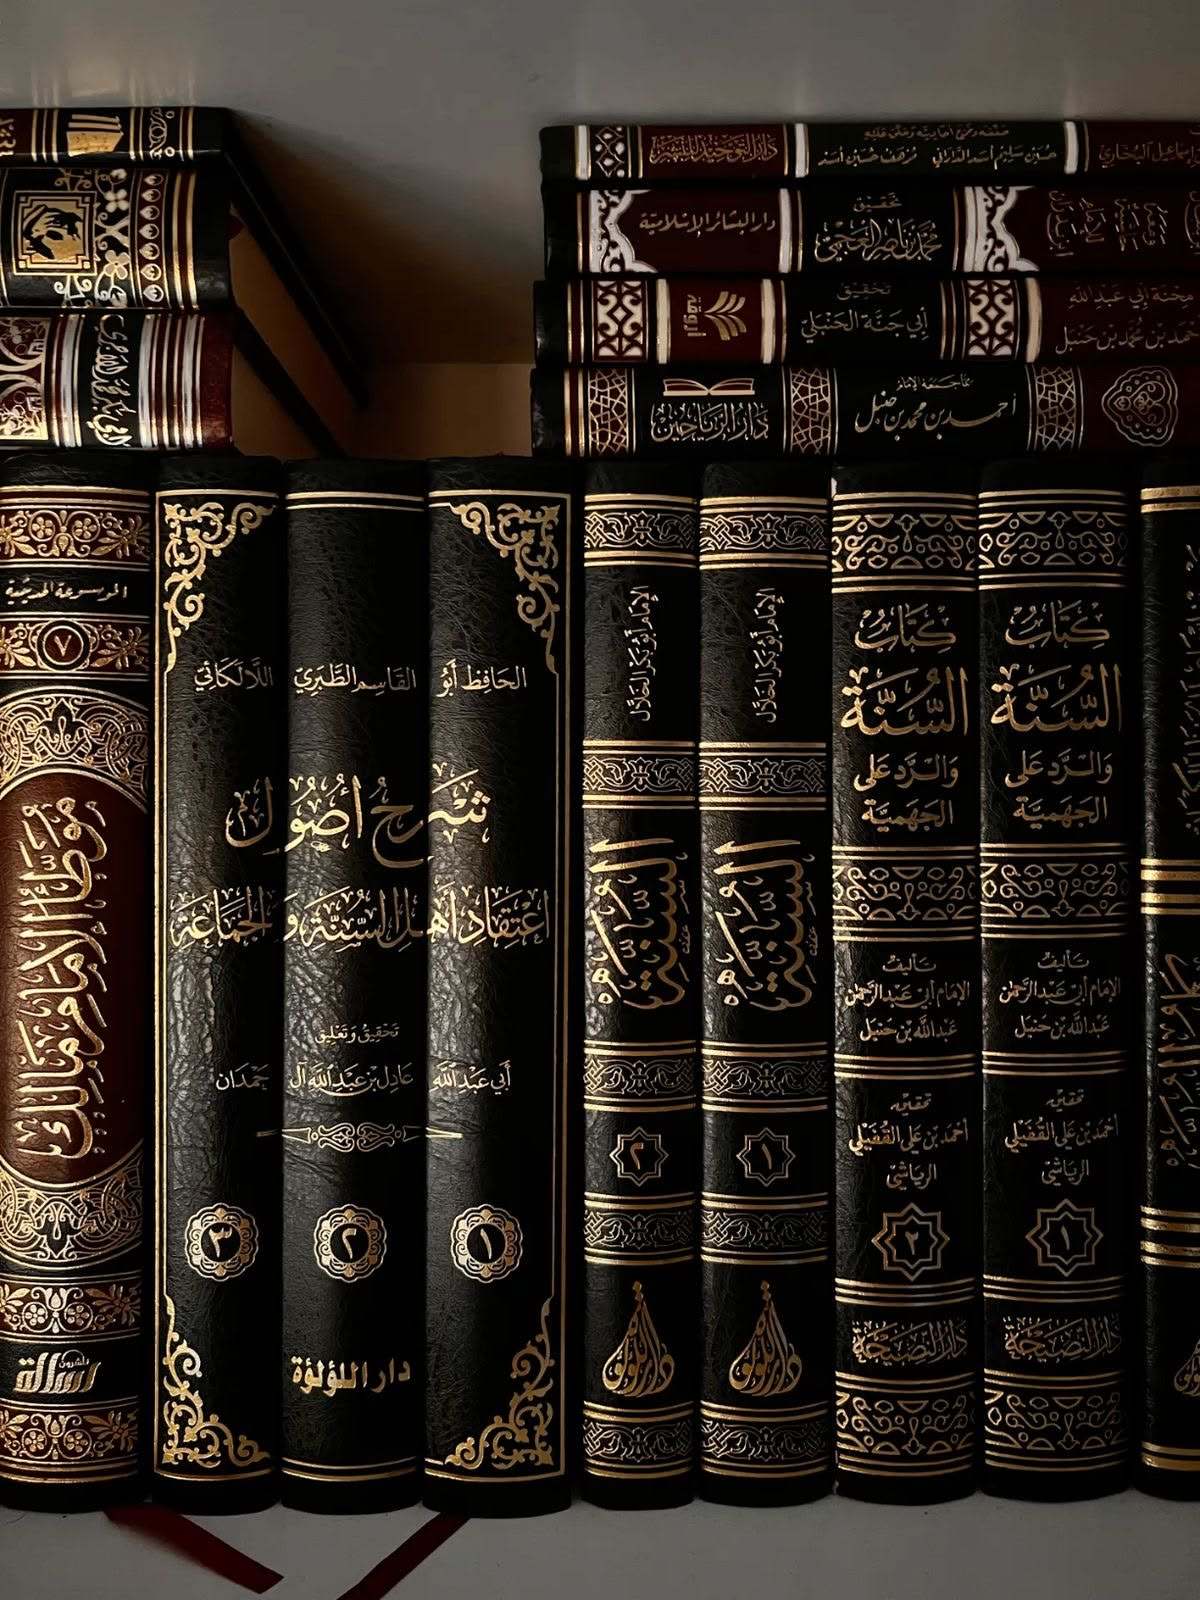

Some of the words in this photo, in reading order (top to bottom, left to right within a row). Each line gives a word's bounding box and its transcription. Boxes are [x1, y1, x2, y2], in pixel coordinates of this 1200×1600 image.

[758, 209, 775, 231] دار
[884, 409, 905, 440] بن
[901, 401, 927, 430] محمد
[924, 408, 944, 440] بن
[943, 393, 1017, 428] أحمد
[628, 585, 659, 630] الإمام
[753, 587, 785, 632] الإمام
[853, 602, 957, 652] كتاب
[1004, 600, 1111, 650] كتاب
[54, 634, 73, 657] ٧
[628, 642, 657, 676] بكر
[752, 644, 782, 678] بكر
[294, 662, 356, 697] الطبري
[356, 665, 417, 696] القاسم
[437, 659, 459, 697] أبو
[463, 666, 527, 692] الحافظ
[627, 670, 652, 722] الخلال
[752, 672, 777, 724] الخلال
[840, 663, 969, 736] السنة
[988, 661, 1123, 736] السنة
[853, 752, 892, 792] على
[894, 752, 960, 788] والرد
[1004, 750, 1045, 789] على
[1048, 749, 1113, 786] والرد
[861, 798, 954, 833] الجهمية
[1012, 795, 1109, 830] الجهمية
[299, 886, 388, 952] السنة
[459, 886, 550, 950] اعتقاد
[589, 838, 691, 1010] السنة
[713, 839, 817, 1012] السنة
[937, 980, 970, 1007] الإمام
[1090, 978, 1122, 1006] الإمام
[315, 1023, 356, 1045] وتعليق
[358, 1023, 399, 1045] تحقيق
[859, 1016, 897, 1042] حنبل
[896, 1020, 913, 1044] بن
[1014, 1015, 1051, 1040] حنبل
[1051, 1019, 1067, 1041] بن
[215, 1063, 271, 1092] حمدان
[378, 1064, 415, 1090] عادل
[490, 1061, 512, 1096] أبي
[16, 1030, 108, 1159] مالك
[938, 1118, 969, 1145] أحمد
[1092, 1113, 1120, 1140] أحمد
[630, 1142, 644, 1170] ٢
[762, 1143, 772, 1170] ١
[208, 1227, 233, 1257] ٣
[342, 1227, 357, 1259] ٢
[479, 1229, 493, 1260] ١
[1060, 1224, 1070, 1251] ١
[290, 1355, 369, 1397] اللؤلؤة
[372, 1357, 410, 1393] دار
